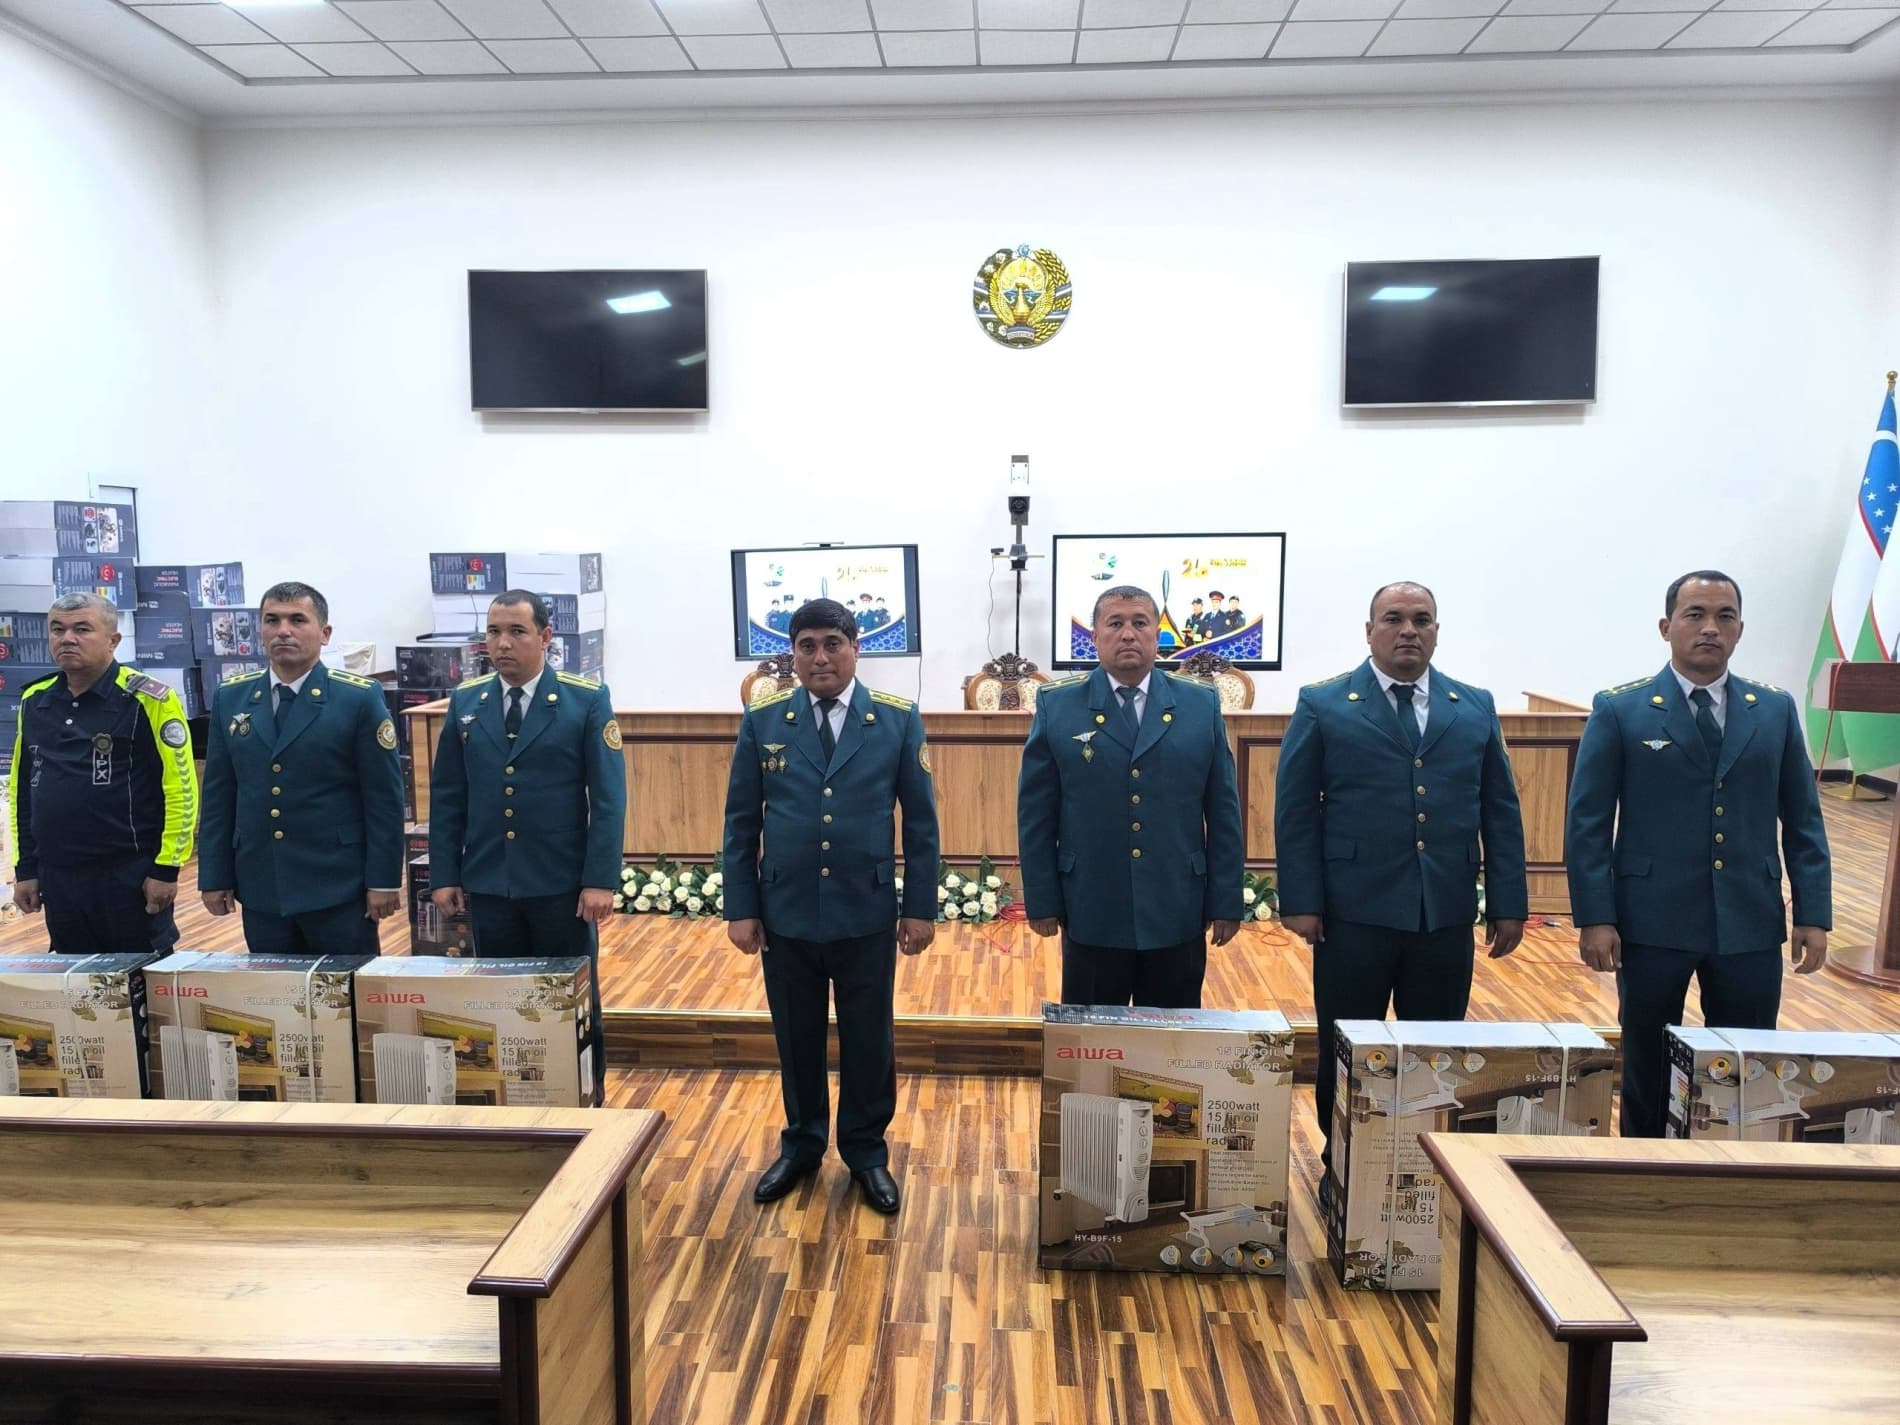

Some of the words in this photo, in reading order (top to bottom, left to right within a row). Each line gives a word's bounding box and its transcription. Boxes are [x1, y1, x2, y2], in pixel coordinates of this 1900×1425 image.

[154, 985, 209, 998] aiwa
[367, 993, 426, 1004] aiwa
[501, 1036, 547, 1046] 2500watt
[62, 1045, 73, 1054] 15
[281, 1043, 293, 1052] 15
[502, 1047, 515, 1056] 15
[534, 1047, 547, 1057] oil
[1216, 1046, 1232, 1056] 15
[1235, 1046, 1255, 1056] FIN
[1260, 1047, 1281, 1057] OIL
[1056, 1047, 1124, 1060] aiwa
[502, 1057, 528, 1066] filled
[1167, 1058, 1212, 1069] FILLED
[1215, 1060, 1281, 1071] RADIATOR
[1525, 1074, 1576, 1083] H-B9F-15
[1207, 1100, 1260, 1111] 2500watt
[1208, 1111, 1222, 1122] 15
[1244, 1112, 1259, 1123] oil
[1206, 1123, 1237, 1134] filled
[1404, 1190, 1436, 1201] filled
[1419, 1202, 1434, 1212] 15
[1381, 1214, 1435, 1225] 2500wtt
[1074, 1234, 1122, 1243] HY-B9F-15
[1359, 1252, 1426, 1263] RADITOR
[1361, 1266, 1380, 1276] OIL
